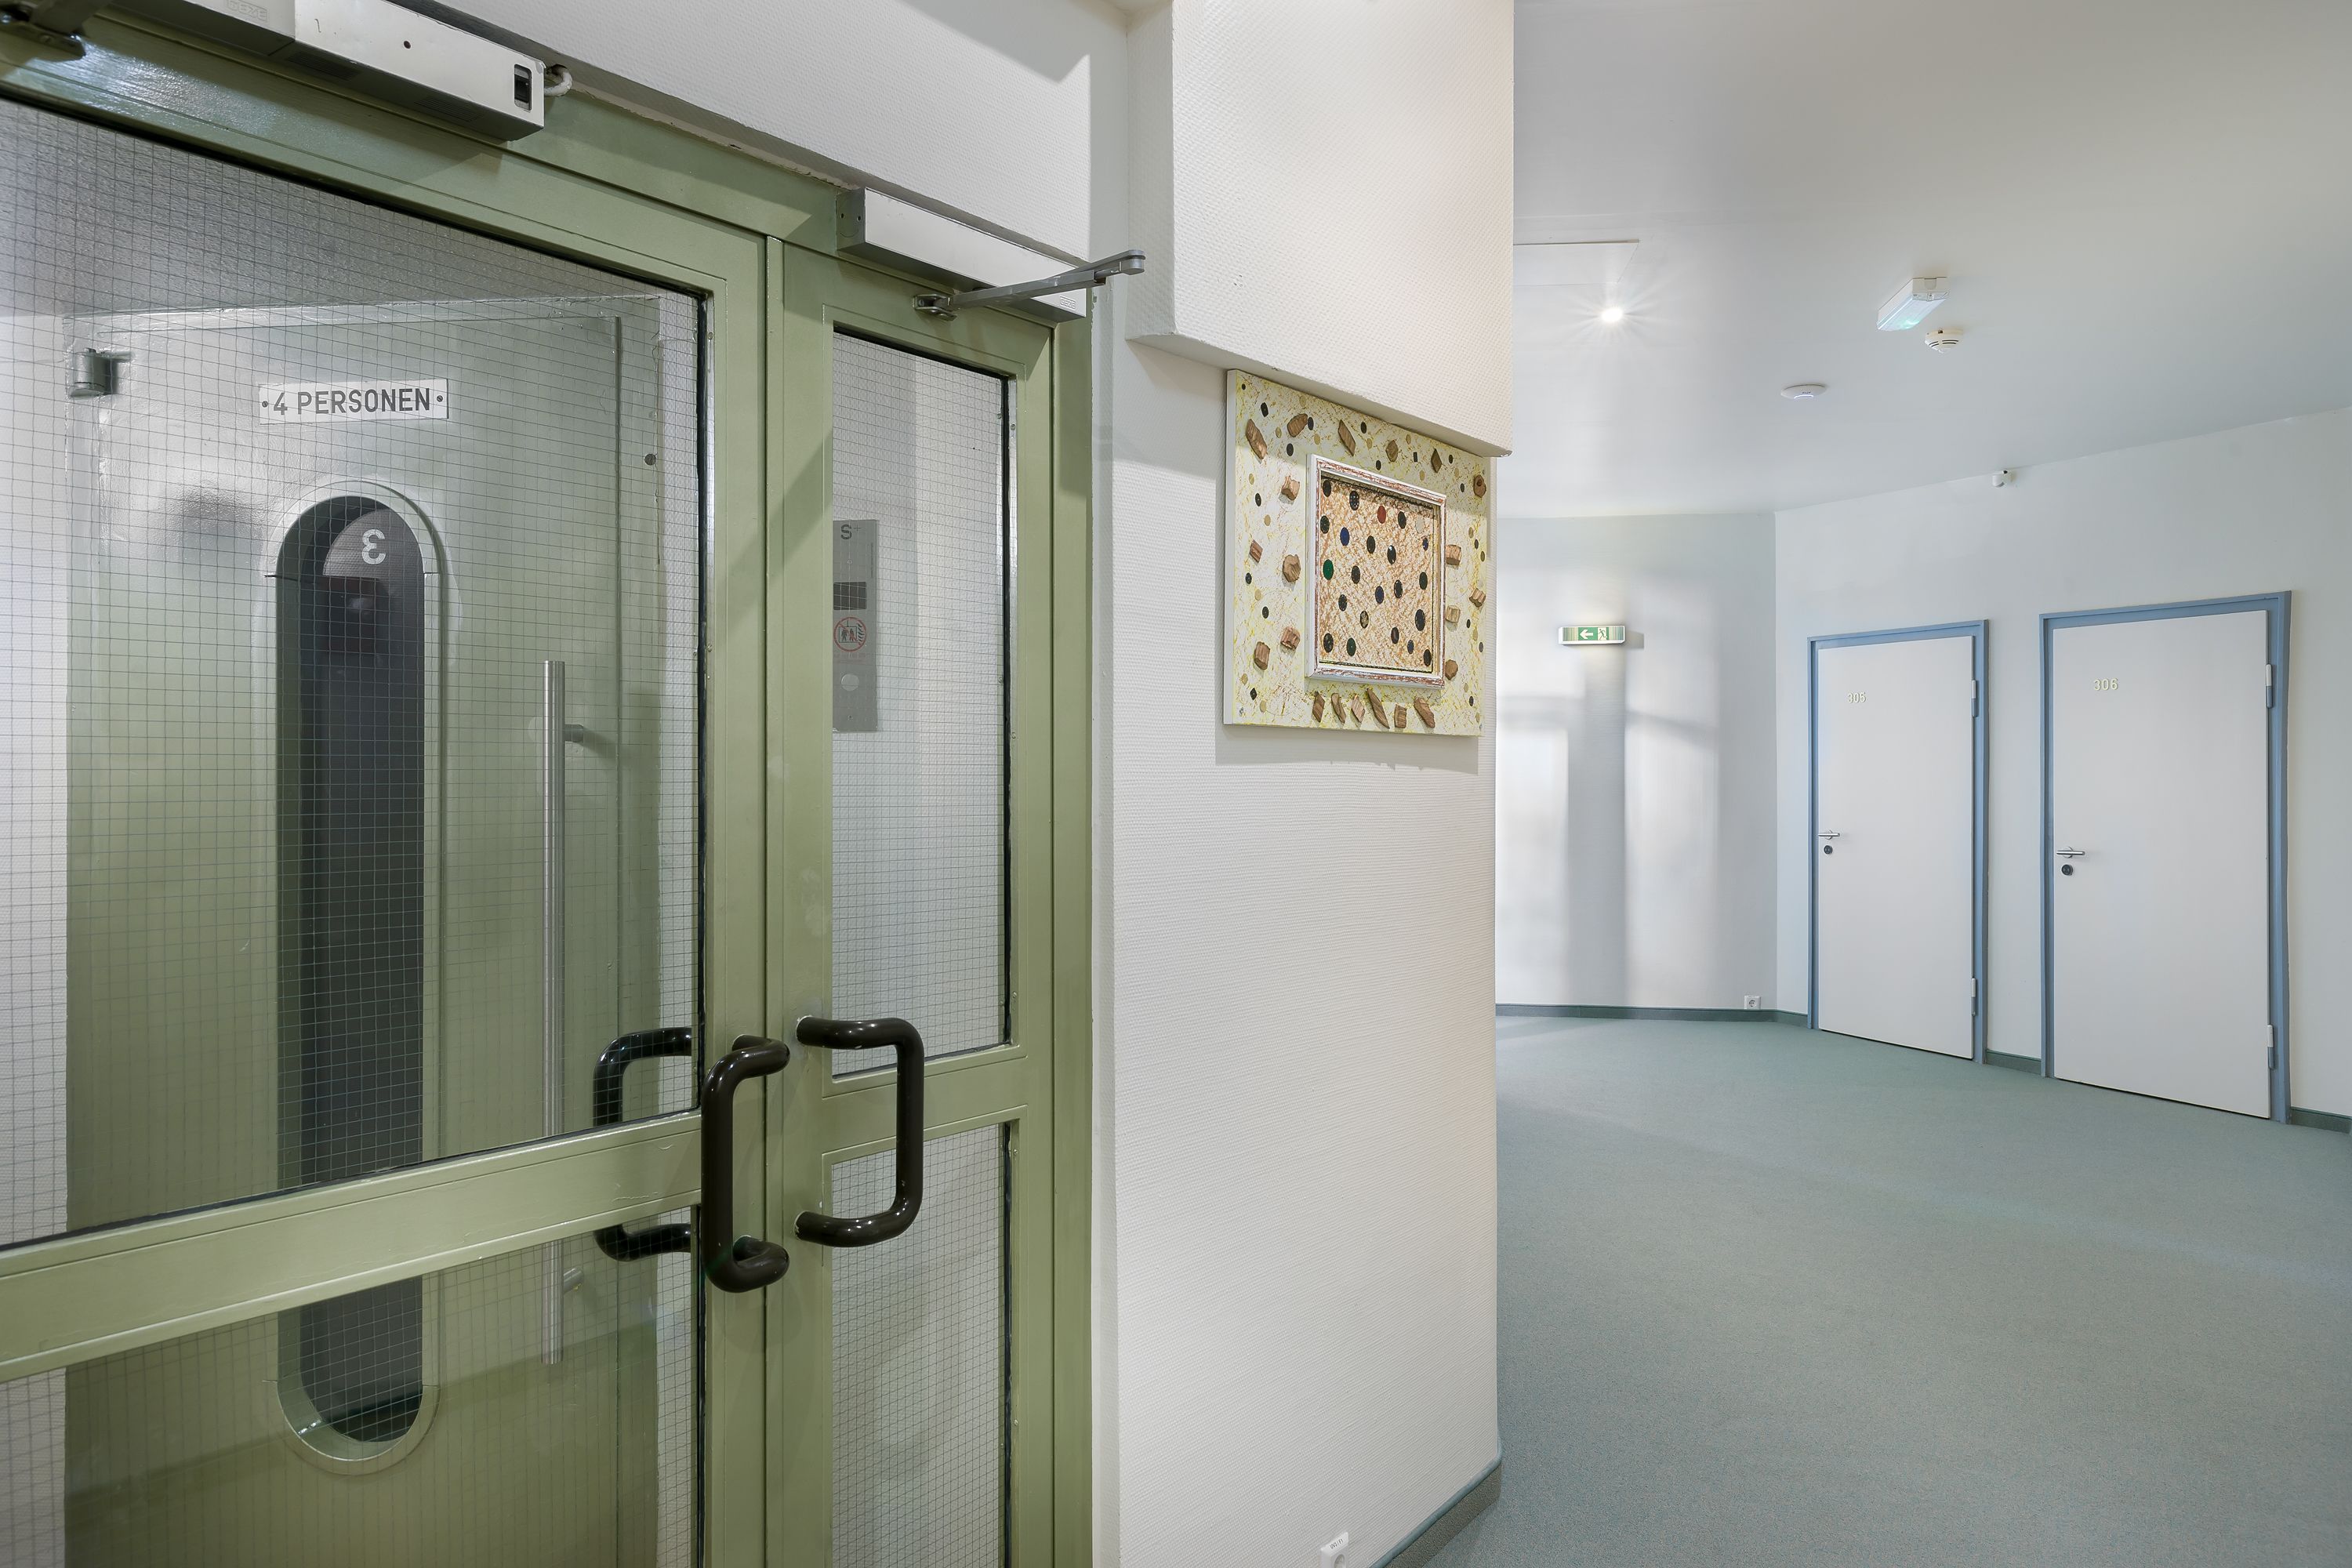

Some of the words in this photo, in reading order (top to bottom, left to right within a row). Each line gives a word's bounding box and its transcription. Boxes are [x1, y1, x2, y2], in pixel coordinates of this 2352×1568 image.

[273, 392, 288, 416] 4
[297, 387, 430, 415] PERSONEN
[2094, 678, 2118, 691] 306
[1846, 691, 1867, 703] 305
